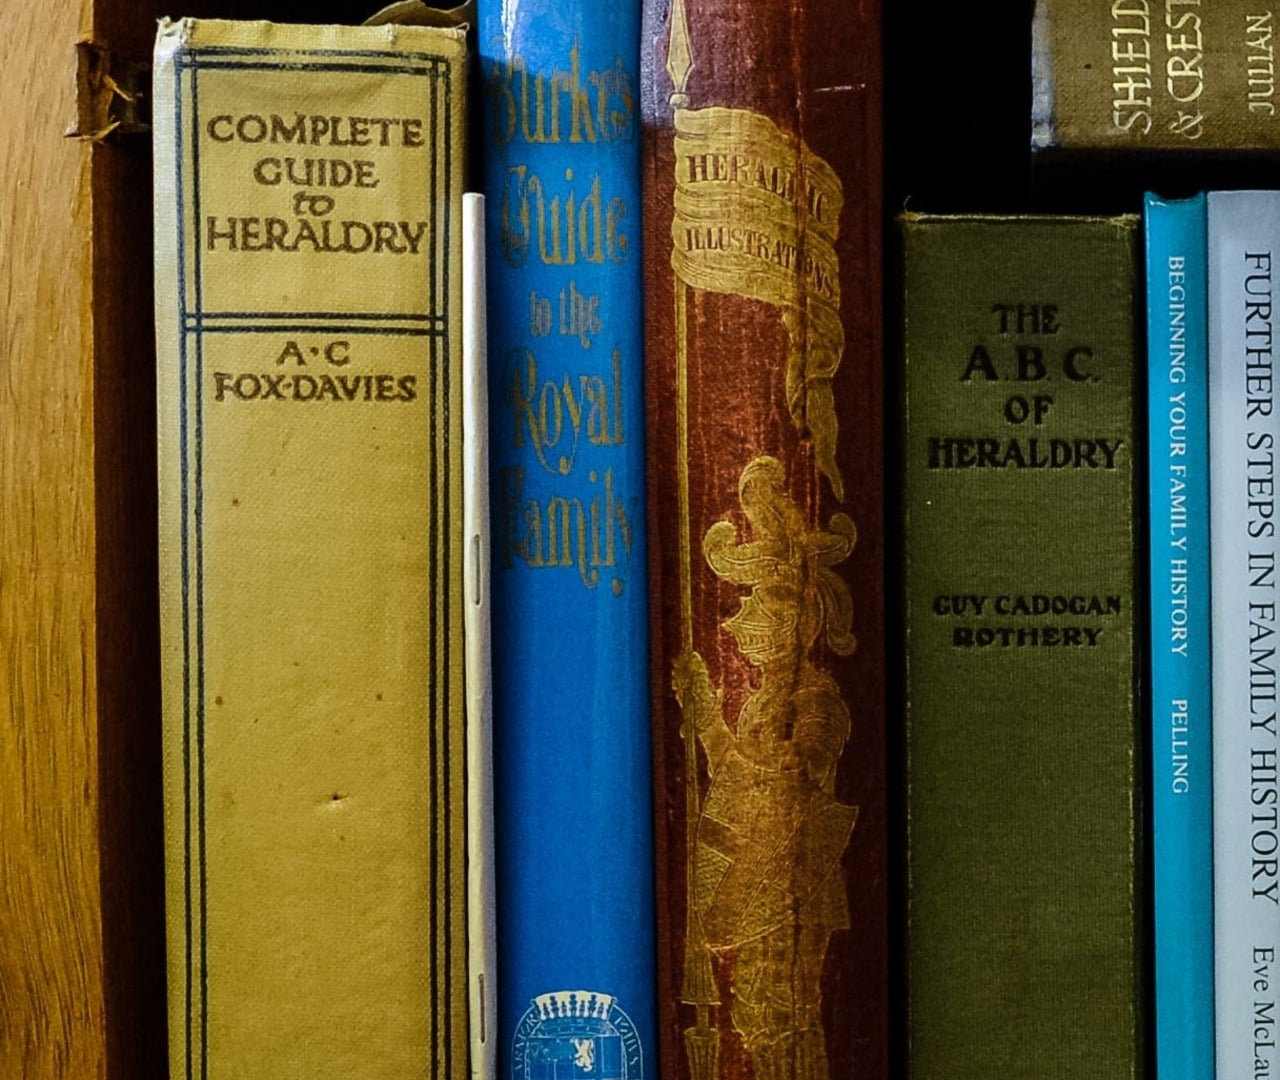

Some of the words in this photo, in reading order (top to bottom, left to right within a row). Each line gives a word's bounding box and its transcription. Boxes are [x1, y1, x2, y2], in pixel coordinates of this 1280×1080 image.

[1246, 11, 1275, 116] JULIAN
[207, 113, 425, 149] COMPLETE
[253, 156, 380, 188] GUIDE
[292, 192, 336, 217] to
[206, 213, 429, 255] HERALDRY
[993, 303, 1061, 335] THE
[1168, 256, 1187, 384] BEGINNING
[1243, 251, 1273, 420] FURTHER
[1003, 395, 1054, 425] OF
[1169, 391, 1188, 457] YOUR
[928, 437, 1125, 470] HERALDRY
[1170, 465, 1188, 551] FAMILY
[1246, 432, 1275, 539] STEPS
[1248, 550, 1276, 589] IN
[932, 594, 988, 616] GUY
[994, 594, 1122, 616] CADOGAN
[1171, 559, 1189, 658] HISTORY
[952, 626, 1104, 647] ROTHERY
[1248, 602, 1277, 737] FAMILY
[1172, 699, 1190, 794] PELLING
[1250, 748, 1279, 906] HISTORY
[1252, 945, 1276, 992] Eve
